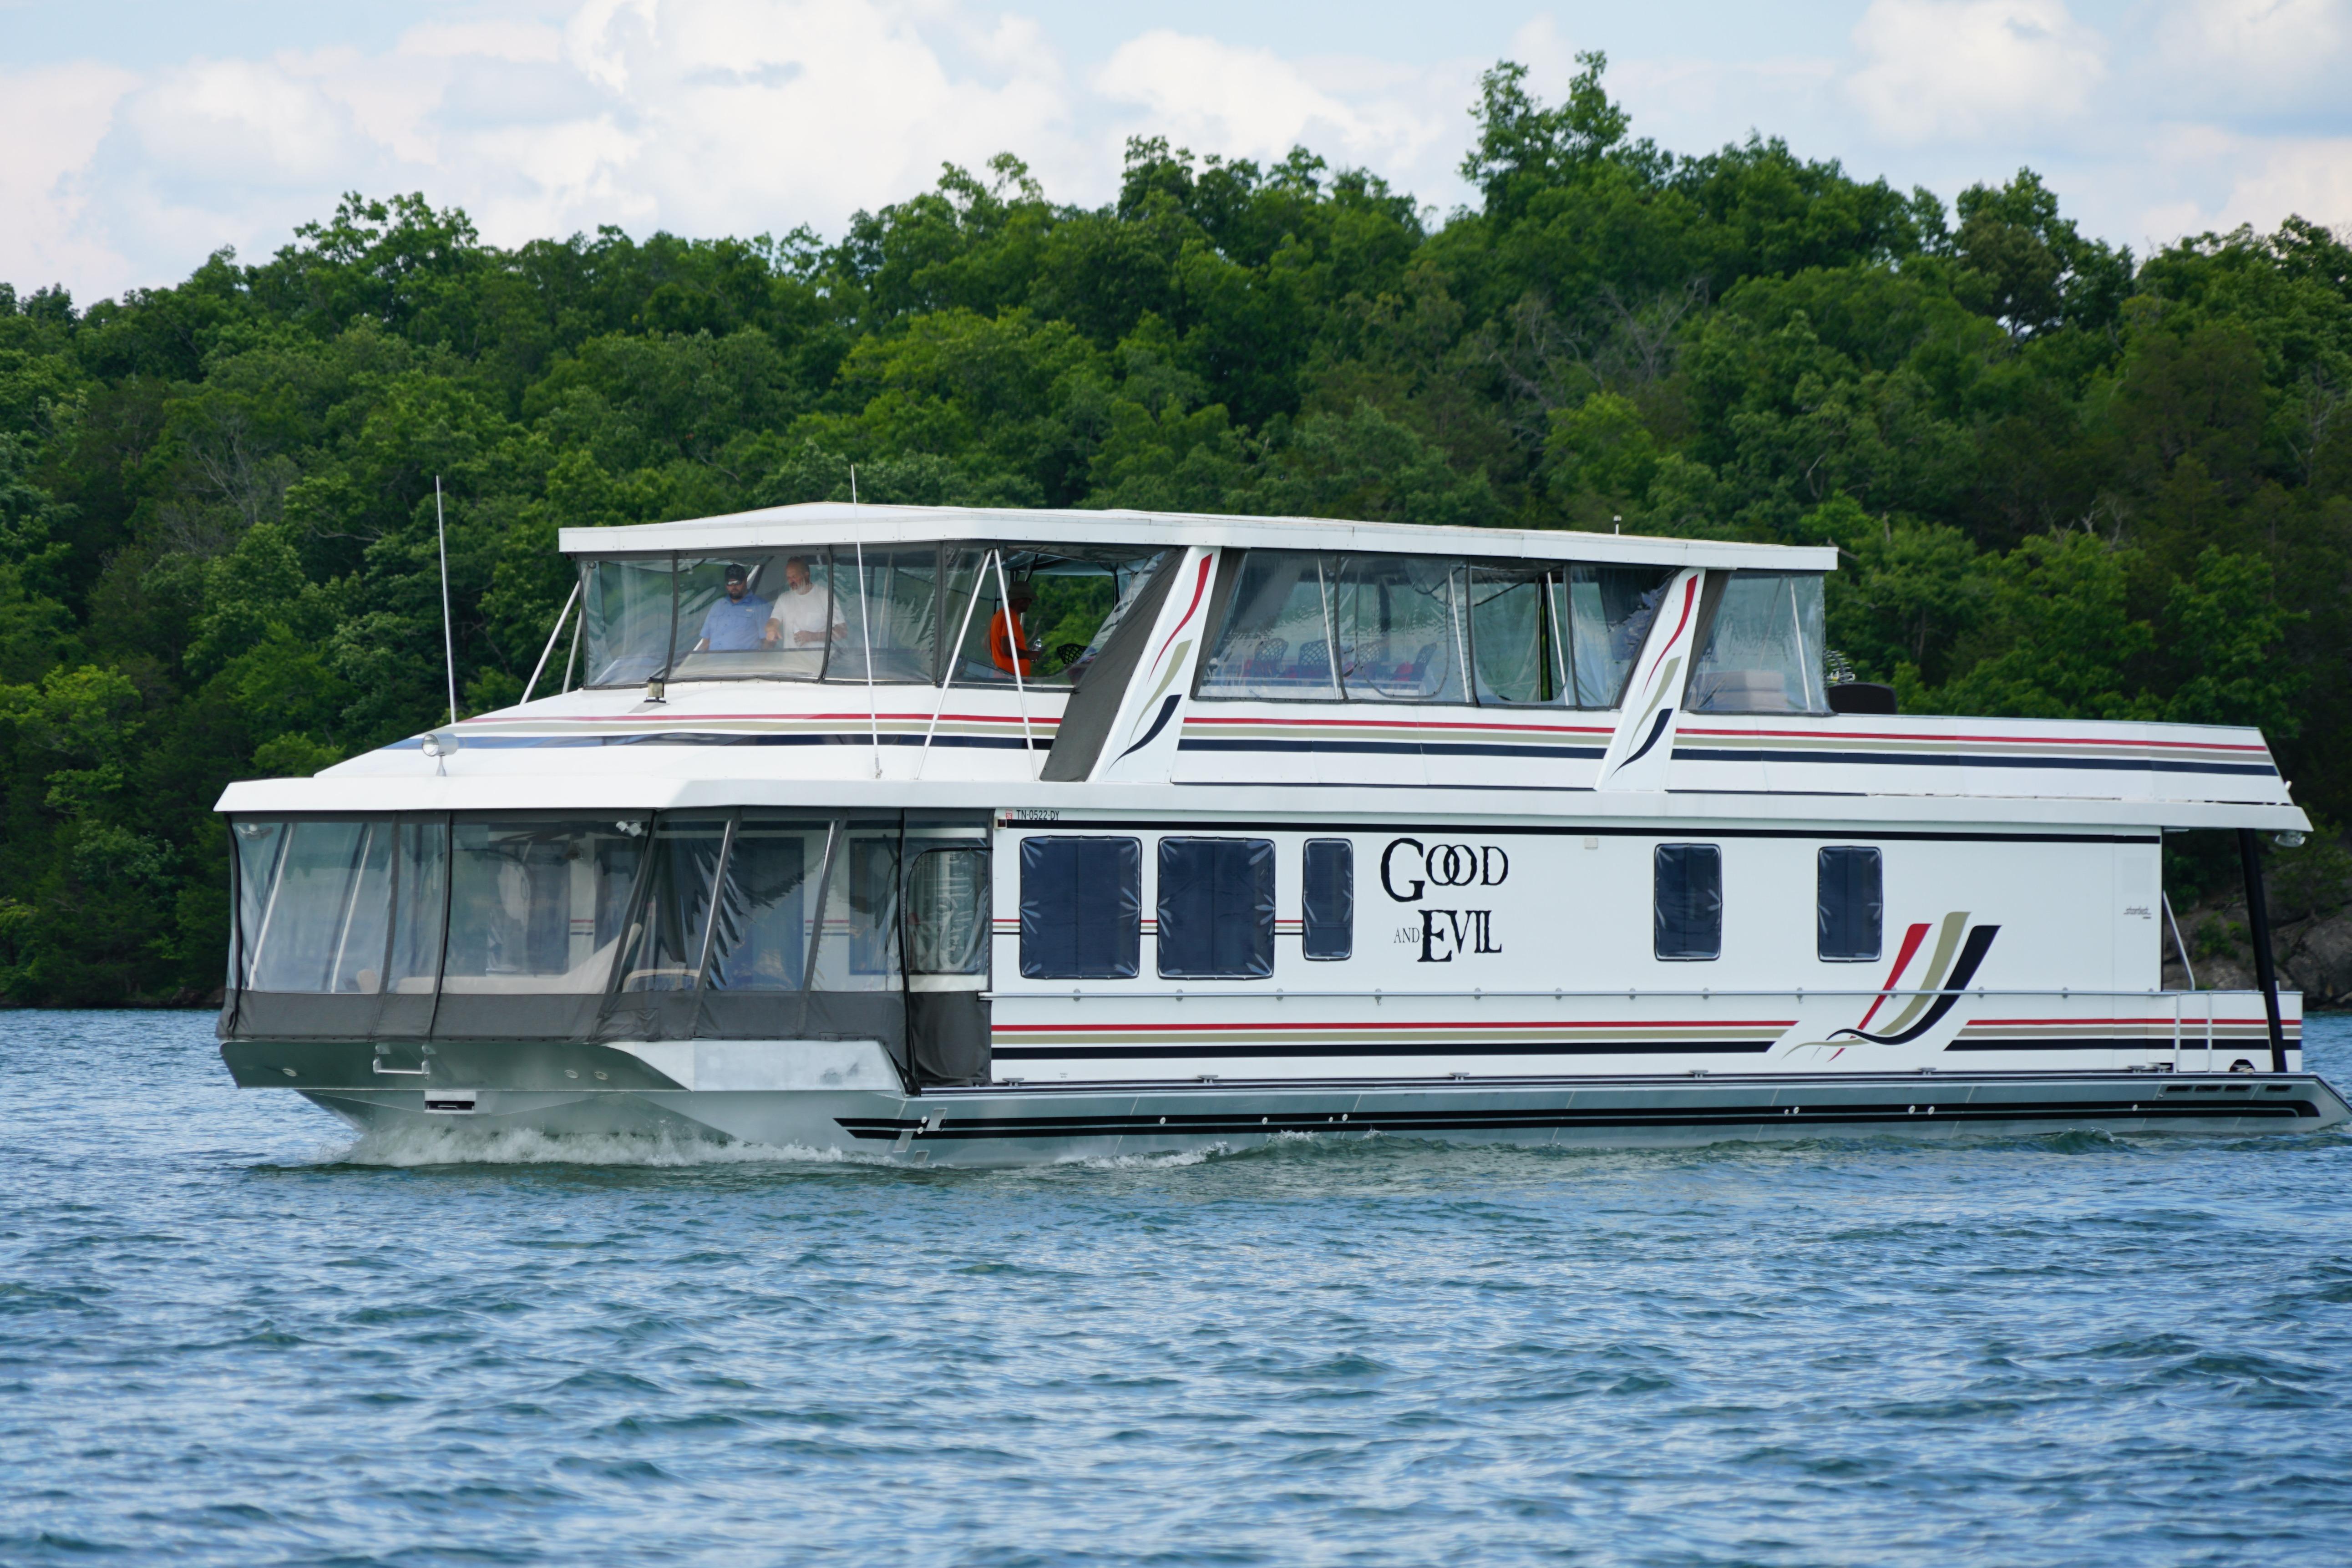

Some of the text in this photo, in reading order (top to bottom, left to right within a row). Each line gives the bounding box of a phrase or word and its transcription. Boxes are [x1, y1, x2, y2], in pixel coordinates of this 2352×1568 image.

[1380, 838, 1508, 902] GOOD
[1394, 909, 1502, 962] AND EVIL
